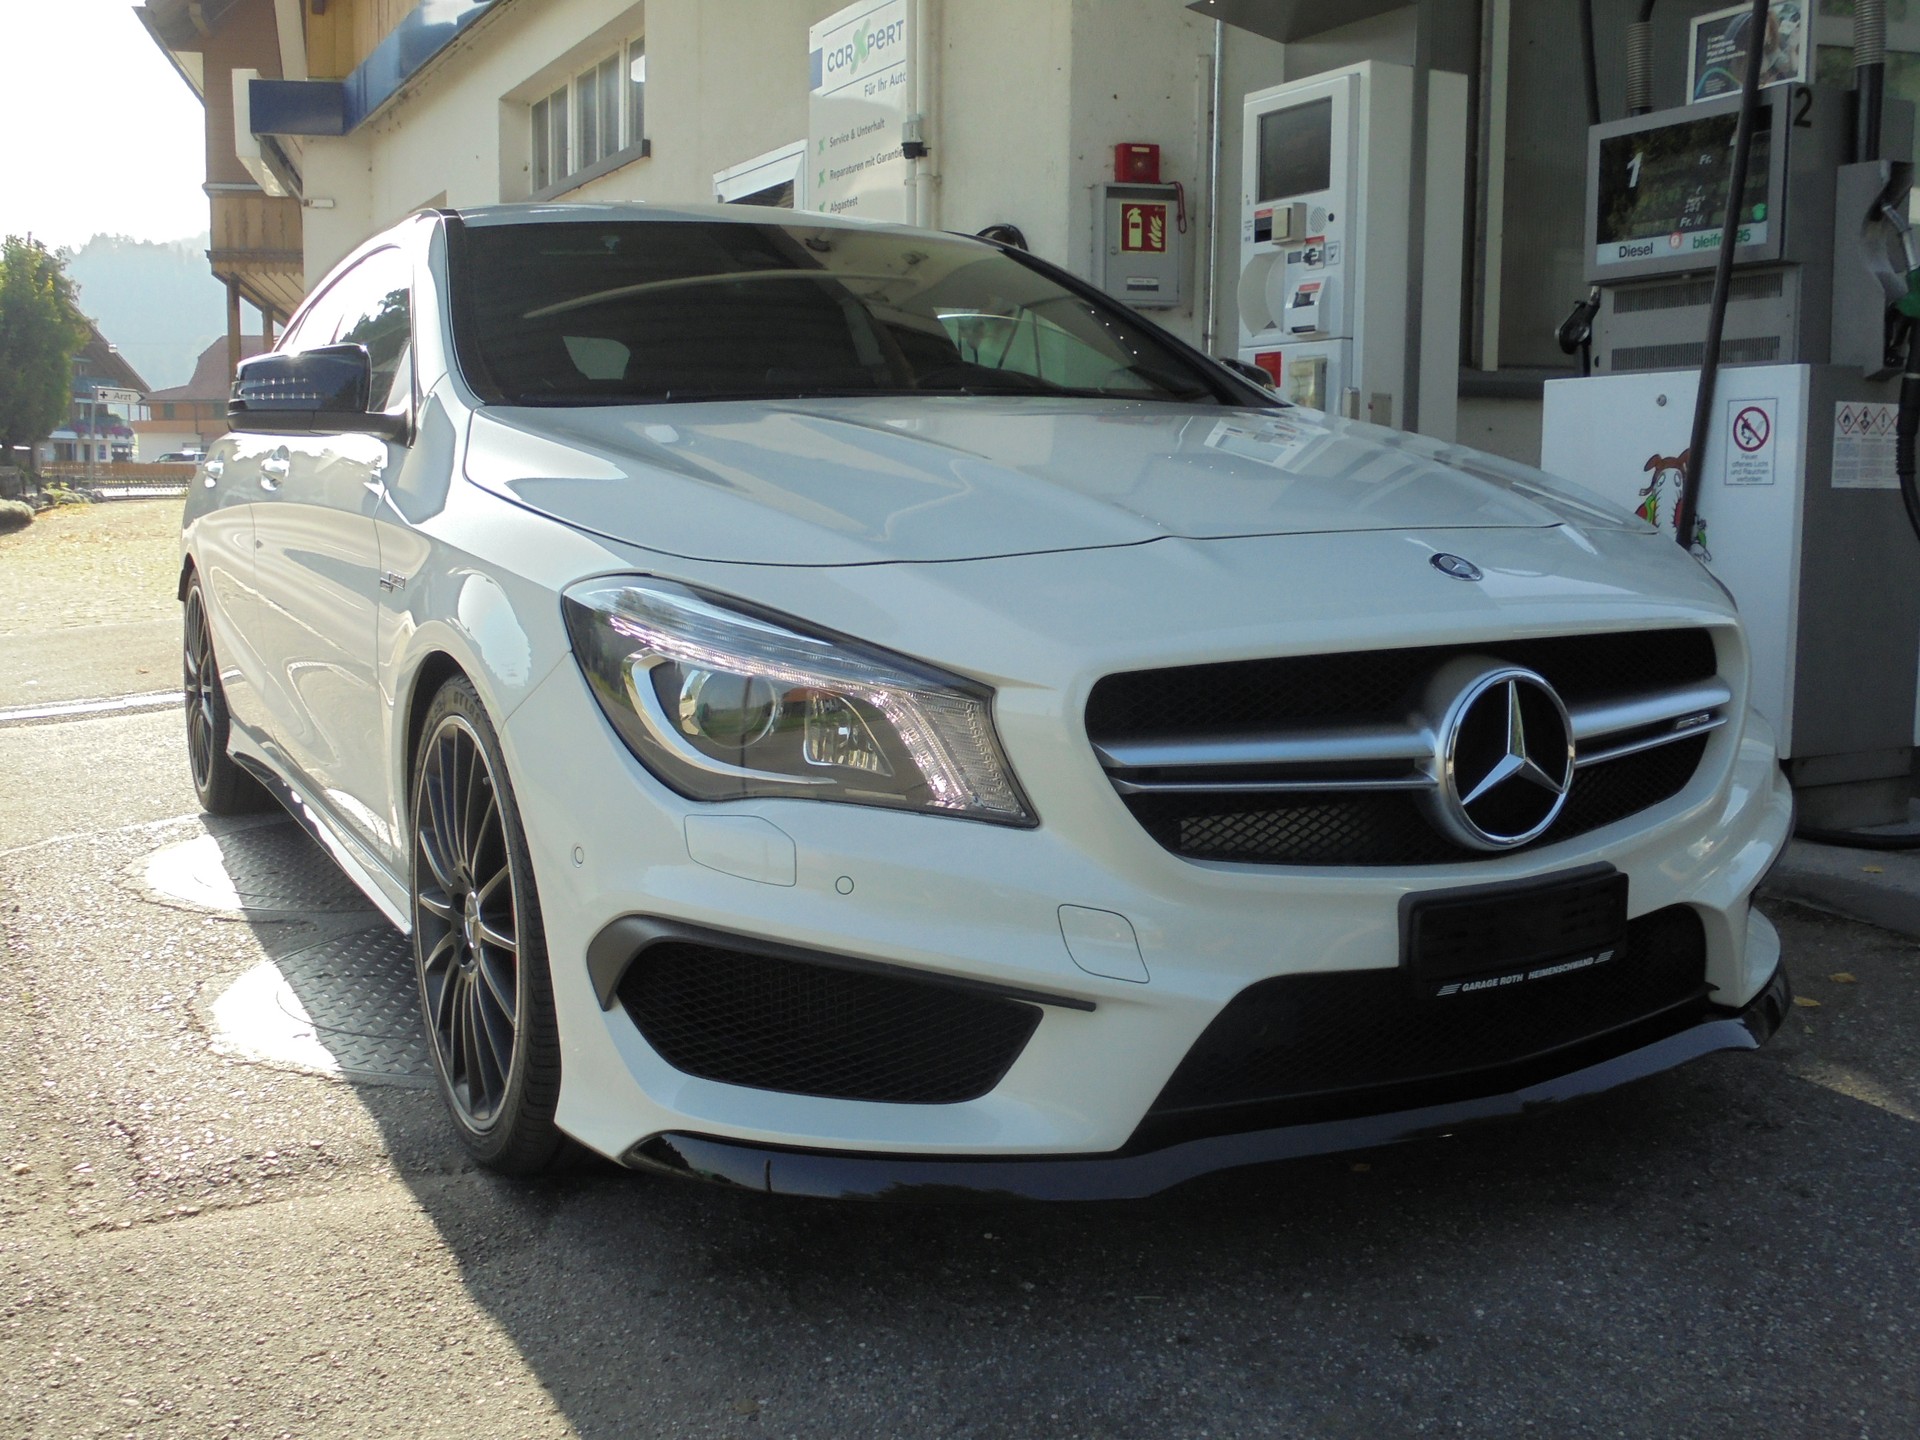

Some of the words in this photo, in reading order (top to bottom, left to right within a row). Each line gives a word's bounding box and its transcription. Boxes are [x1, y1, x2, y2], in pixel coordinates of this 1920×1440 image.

[864, 82, 875, 97] Für
[877, 77, 887, 92] Ihr
[1793, 86, 1812, 127] 2
[829, 132, 849, 147] Service
[850, 128, 856, 140] &
[856, 117, 885, 137] Unterhalt
[829, 161, 864, 180] Reparaturen
[864, 155, 875, 168] mit
[876, 147, 903, 165] Garantie
[1626, 152, 1644, 188] 1
[829, 196, 858, 213] Abgastest
[1618, 242, 1654, 259] Diesel
[113, 392, 132, 401] Arzt
[1462, 977, 1498, 992] GARAGE
[1499, 973, 1524, 987] ROTH
